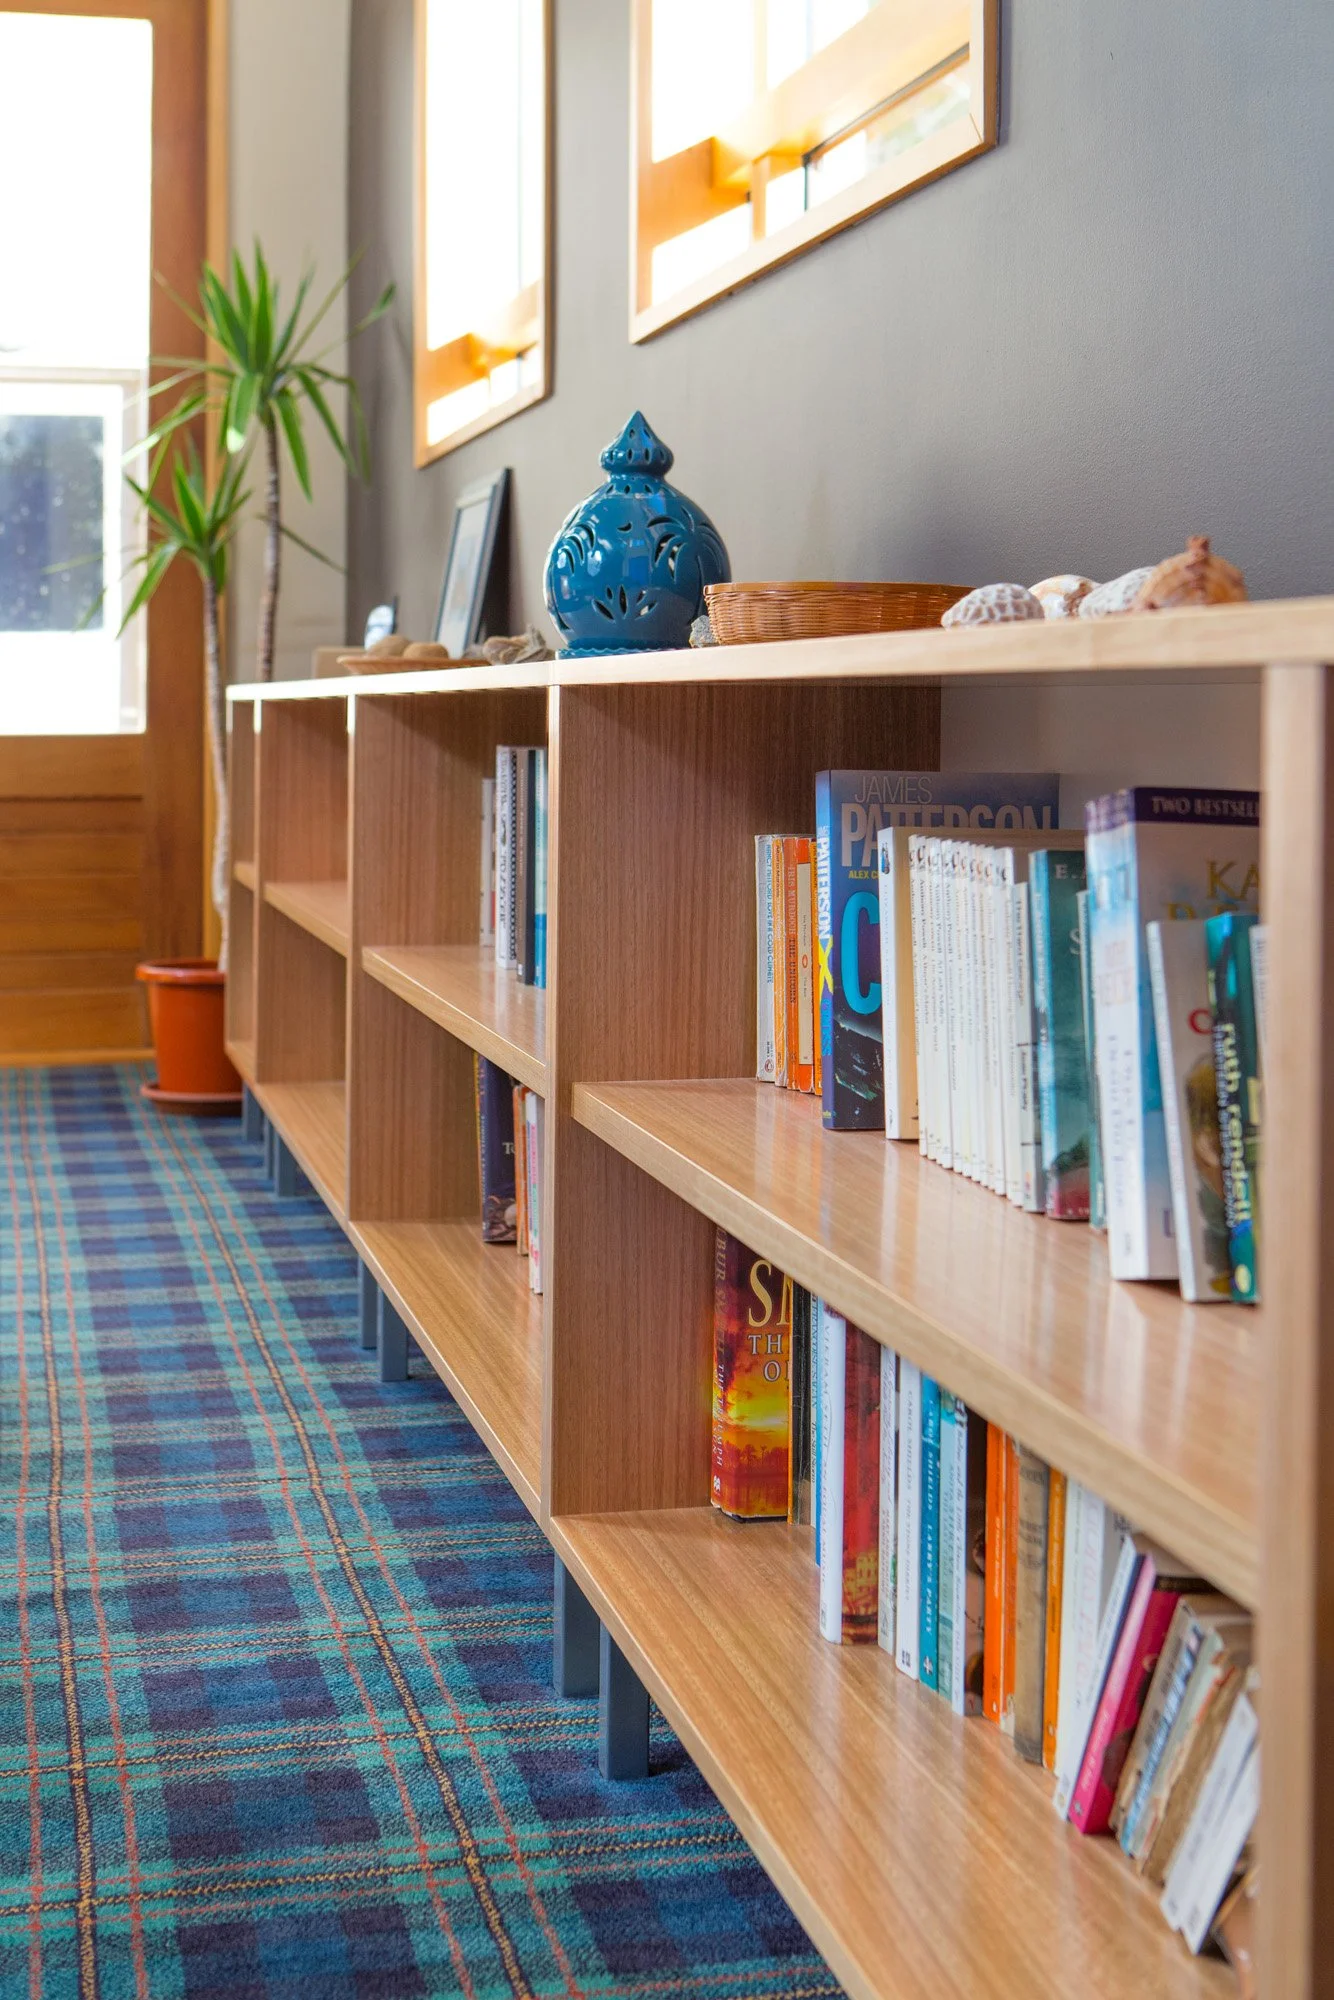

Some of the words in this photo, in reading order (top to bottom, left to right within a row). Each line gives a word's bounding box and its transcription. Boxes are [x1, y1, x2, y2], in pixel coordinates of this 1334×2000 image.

[855, 775, 932, 804] JAMES
[1152, 796, 1191, 815] TWO
[818, 837, 832, 939] PATTERSON
[848, 870, 869, 880] ALEX
[1221, 1022, 1242, 1092] ruth
[1226, 1103, 1252, 1220] rendell
[717, 1364, 725, 1389] THE
[823, 1325, 831, 1395] VIKRAM
[716, 1396, 725, 1466] TRIUMPH
[906, 1391, 914, 1432] CAROL
[906, 1437, 914, 1490] SHIELDS
[926, 1523, 934, 1583] LARRY'S
[925, 1587, 933, 1635] PARTY
